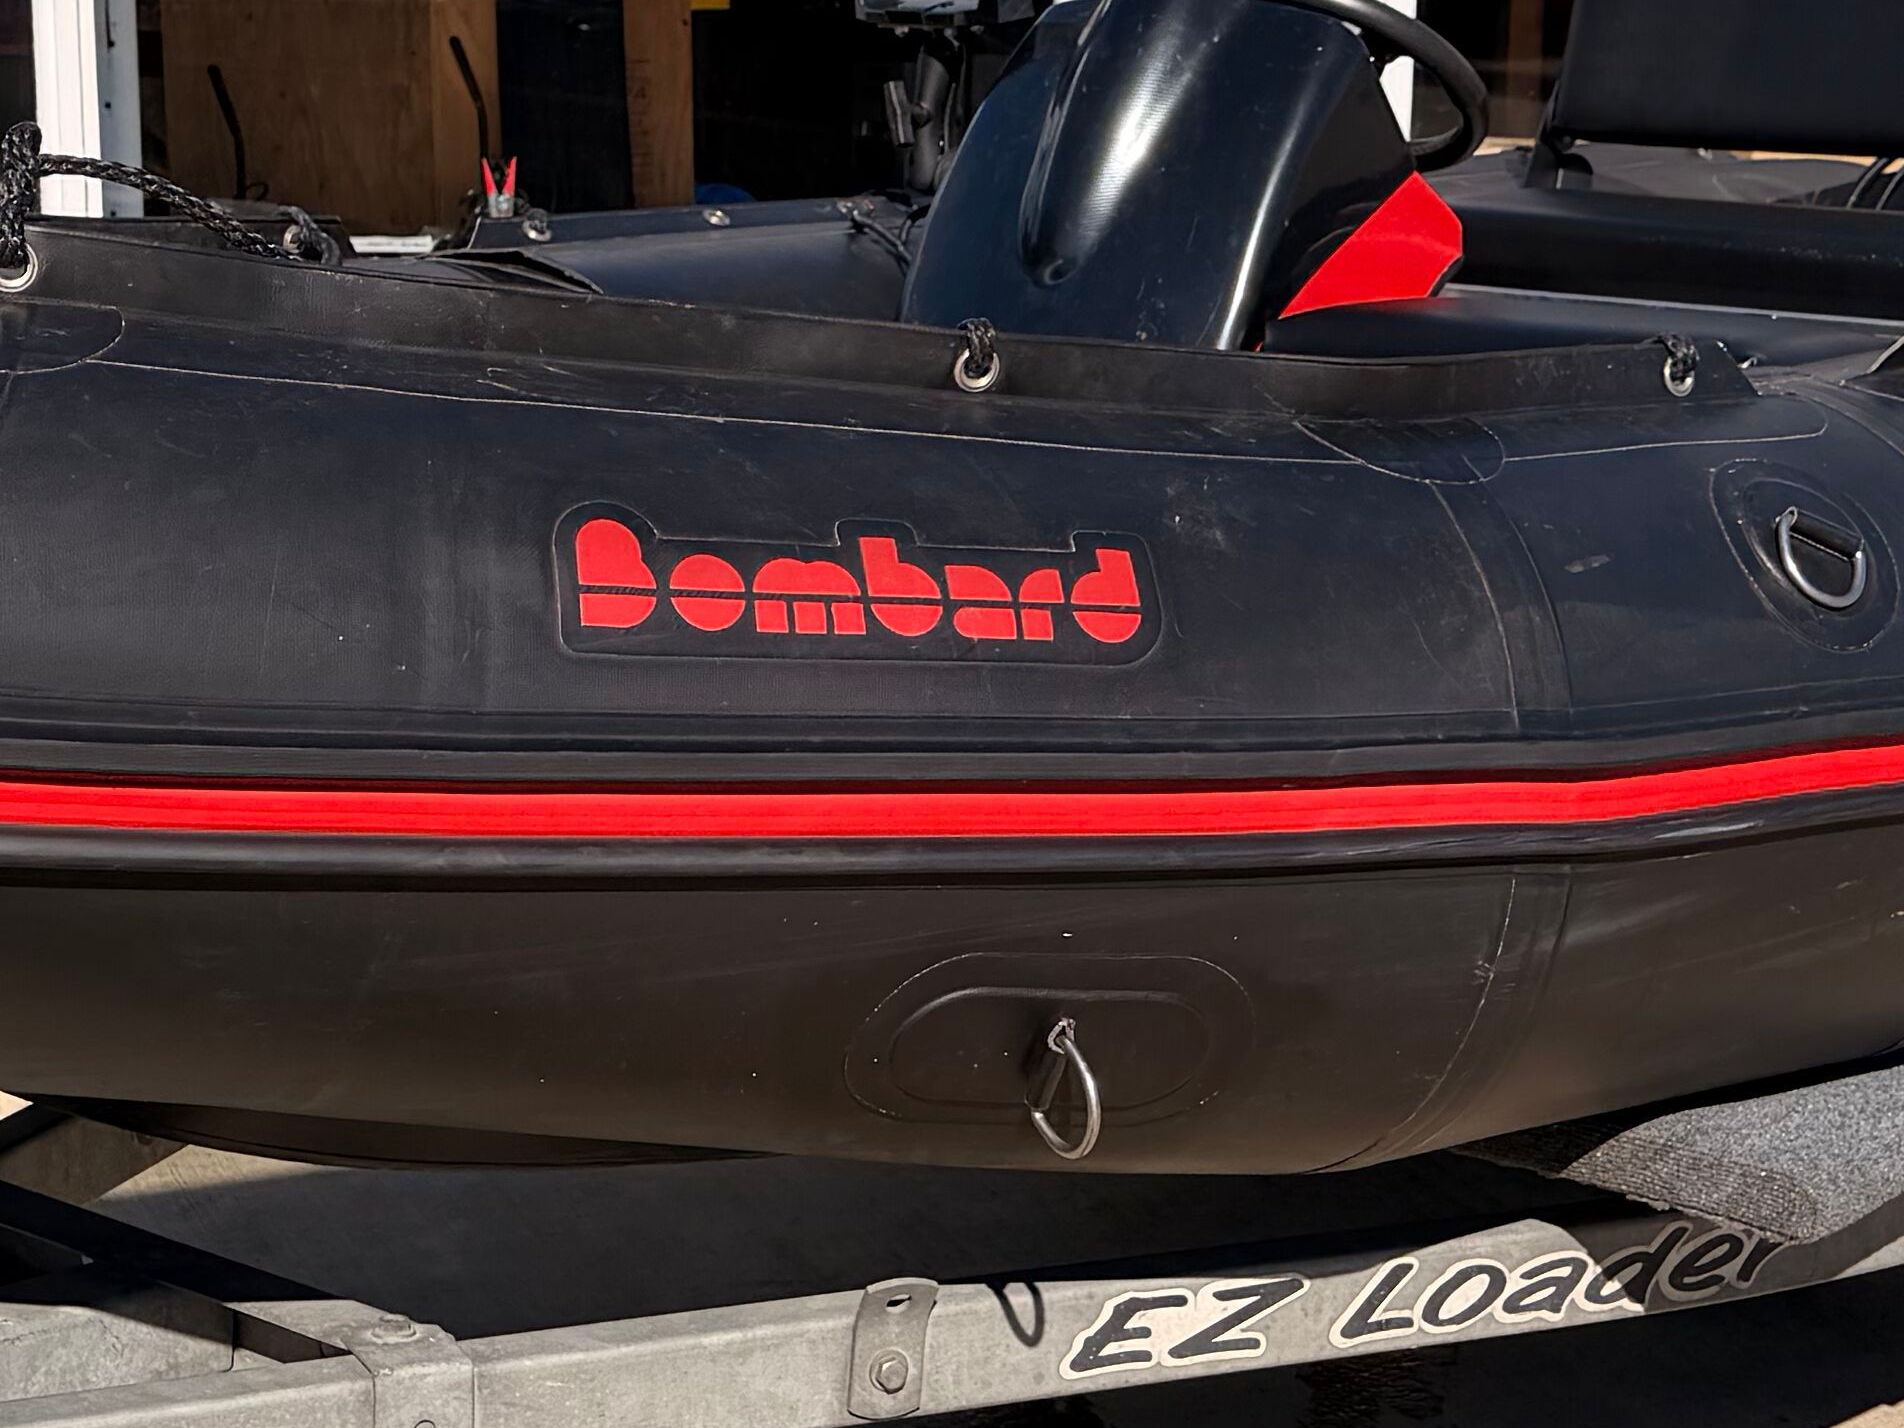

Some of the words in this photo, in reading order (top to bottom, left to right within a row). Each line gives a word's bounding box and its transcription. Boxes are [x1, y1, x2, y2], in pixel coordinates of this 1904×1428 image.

[574, 517, 1143, 645] Bombard
[1068, 1277, 1306, 1375] EZ
[1339, 1225, 1784, 1341] Loader
